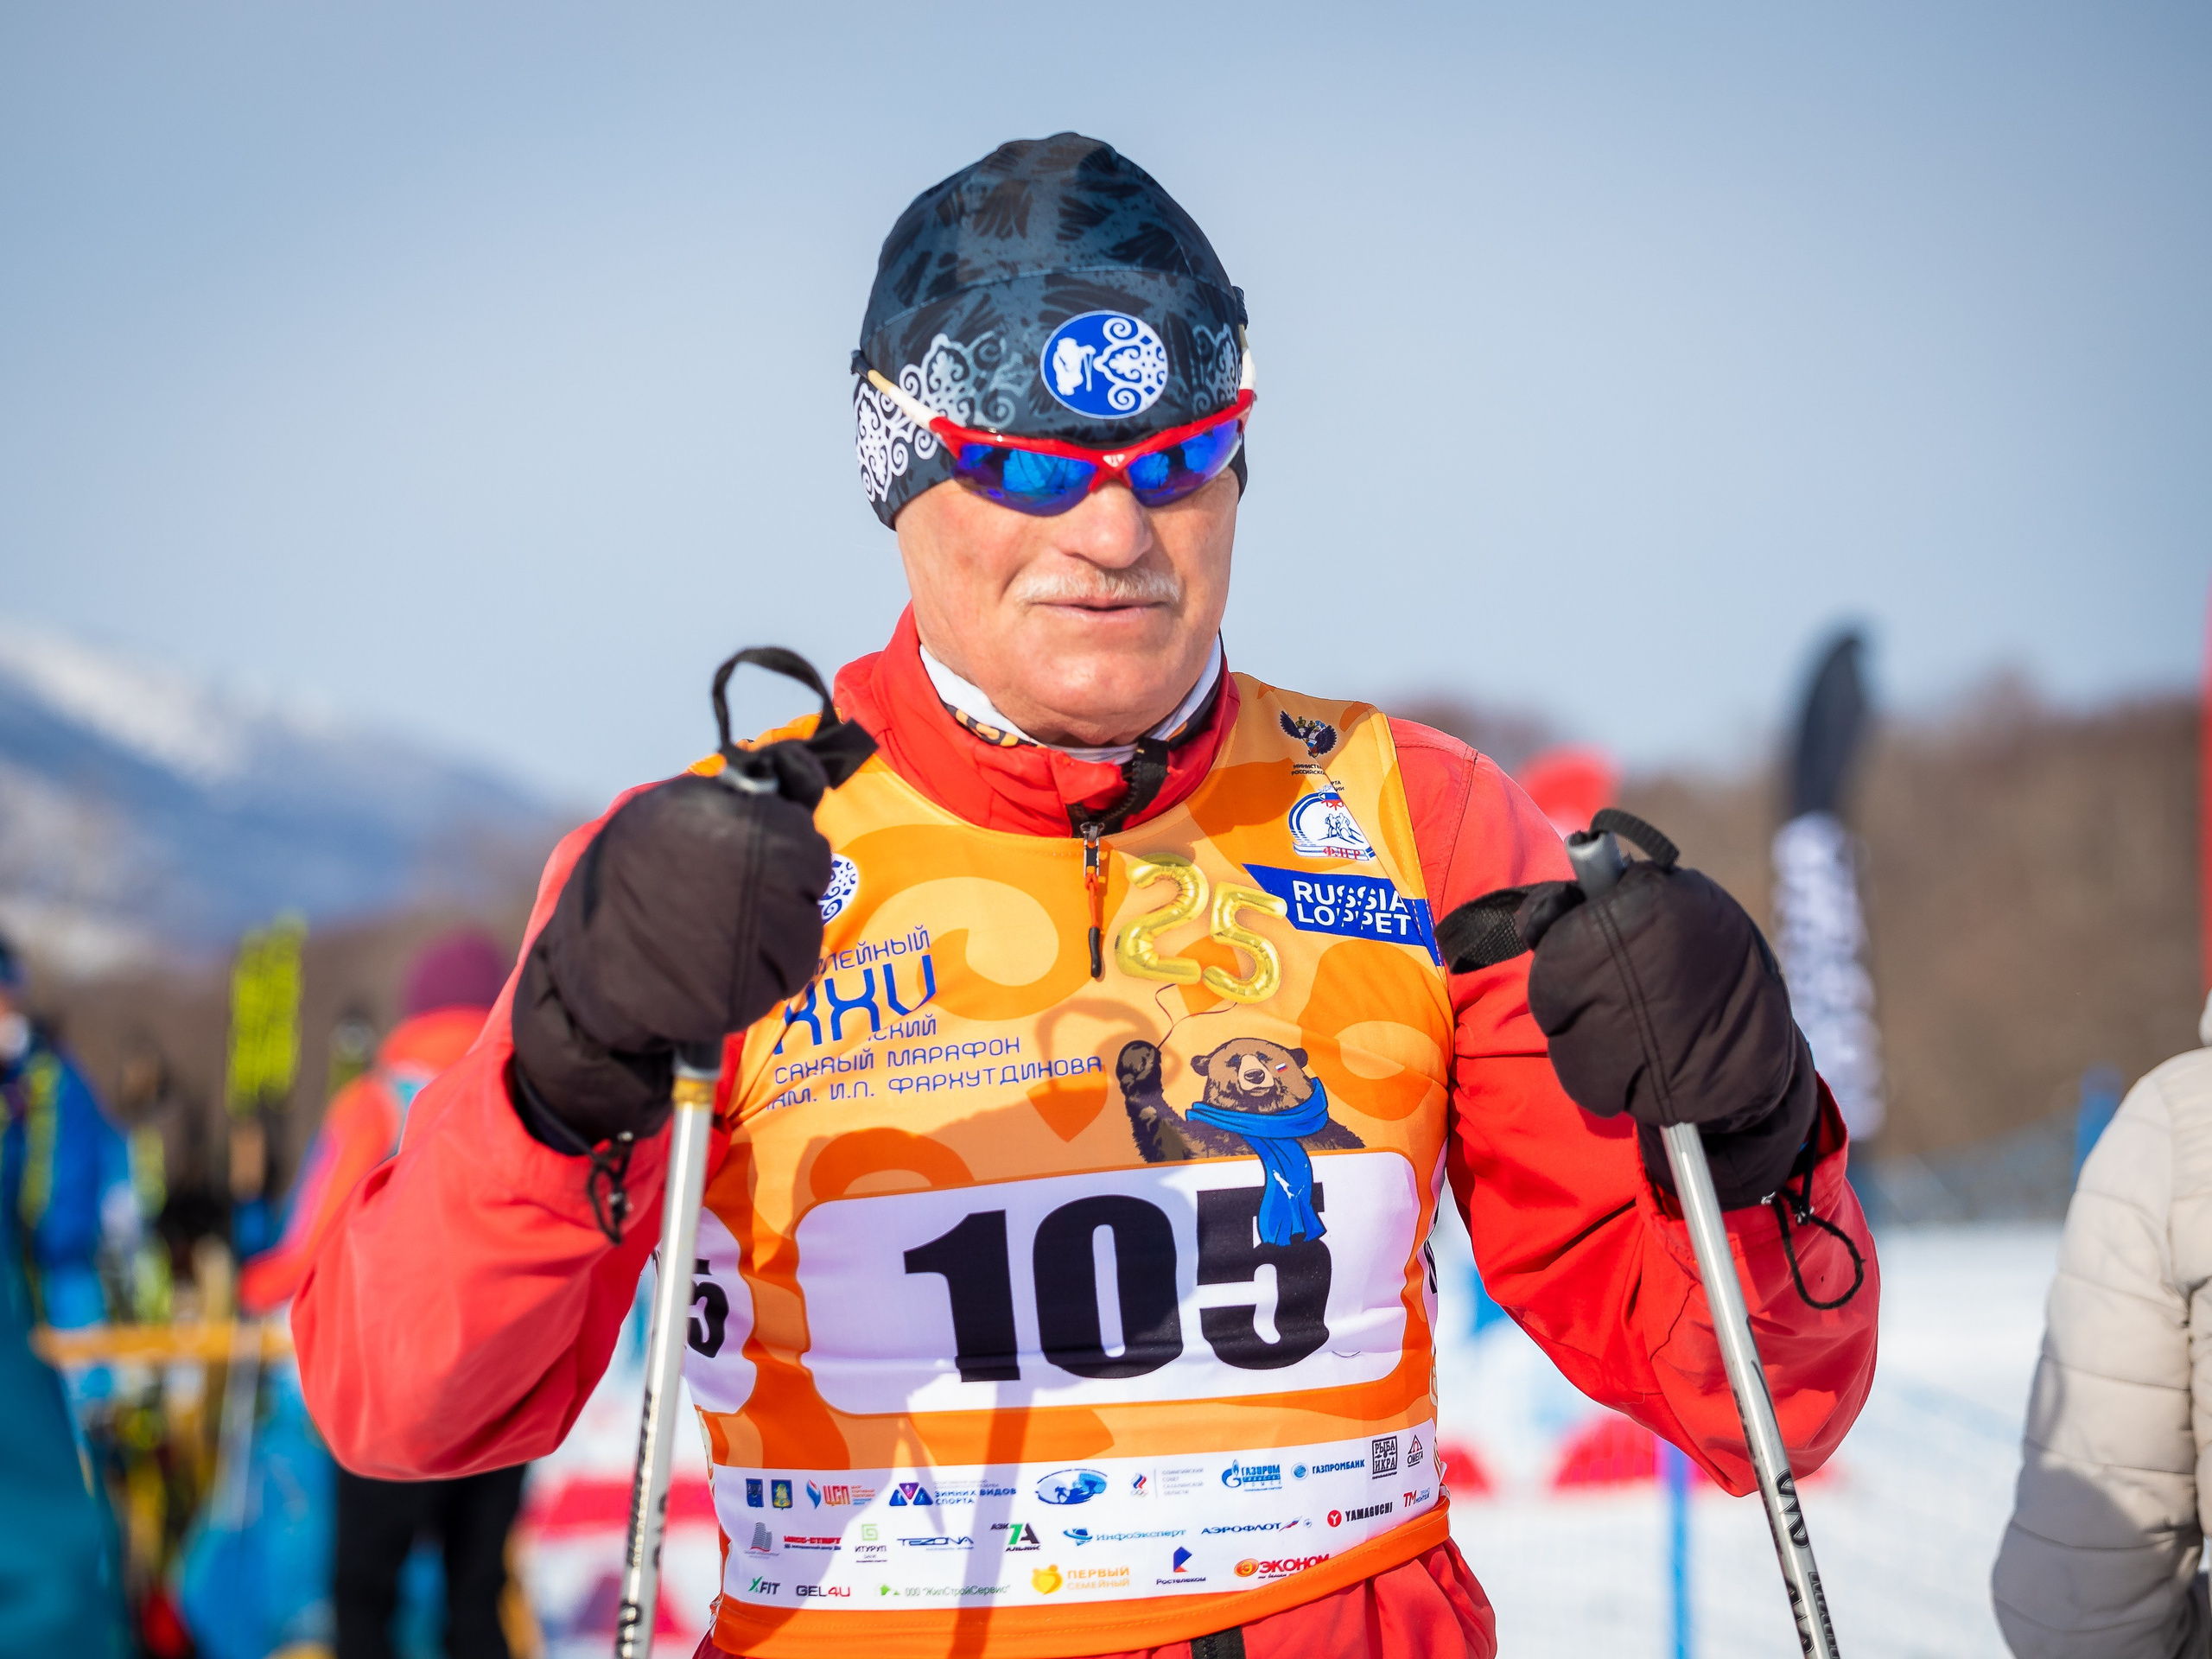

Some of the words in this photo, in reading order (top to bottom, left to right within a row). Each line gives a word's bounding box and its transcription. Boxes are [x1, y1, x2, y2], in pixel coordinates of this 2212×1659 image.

[1292, 880, 1408, 913] RUSSIA
[1296, 903, 1412, 936] LOPPET
[1115, 853, 1287, 1004] 25
[887, 1037, 1020, 1068] МАРАФОН
[830, 1081, 875, 1101] И.П.
[888, 1056, 1103, 1095] ФАРХУТДИНОВА
[903, 1181, 1332, 1382] 105
[1375, 1440, 1395, 1453] РЫБА
[1375, 1458, 1395, 1471] ИКРА
[1407, 1451, 1424, 1465] ОМЕГА
[1241, 1464, 1281, 1476] ГАЗПРОМ
[1312, 1459, 1365, 1474] ГАЗПРОМБАНК
[823, 1484, 851, 1507] ЦСП
[979, 1488, 1016, 1497] ВИДОВ
[1345, 1502, 1393, 1522] YAMAGUCHI
[1096, 1529, 1186, 1541] ИнфоЭксперт
[1201, 1522, 1281, 1535] АЭРОФЛОТ
[1259, 1553, 1330, 1573] ЭКОНОМ
[1067, 1566, 1129, 1579] ПЕРВЫЙ
[748, 1575, 781, 1595] XFIT
[1067, 1578, 1129, 1590] СЕМЕЙНЫЙ
[1156, 1576, 1206, 1585] Ростелеком
[796, 1585, 851, 1597] GEL4U
